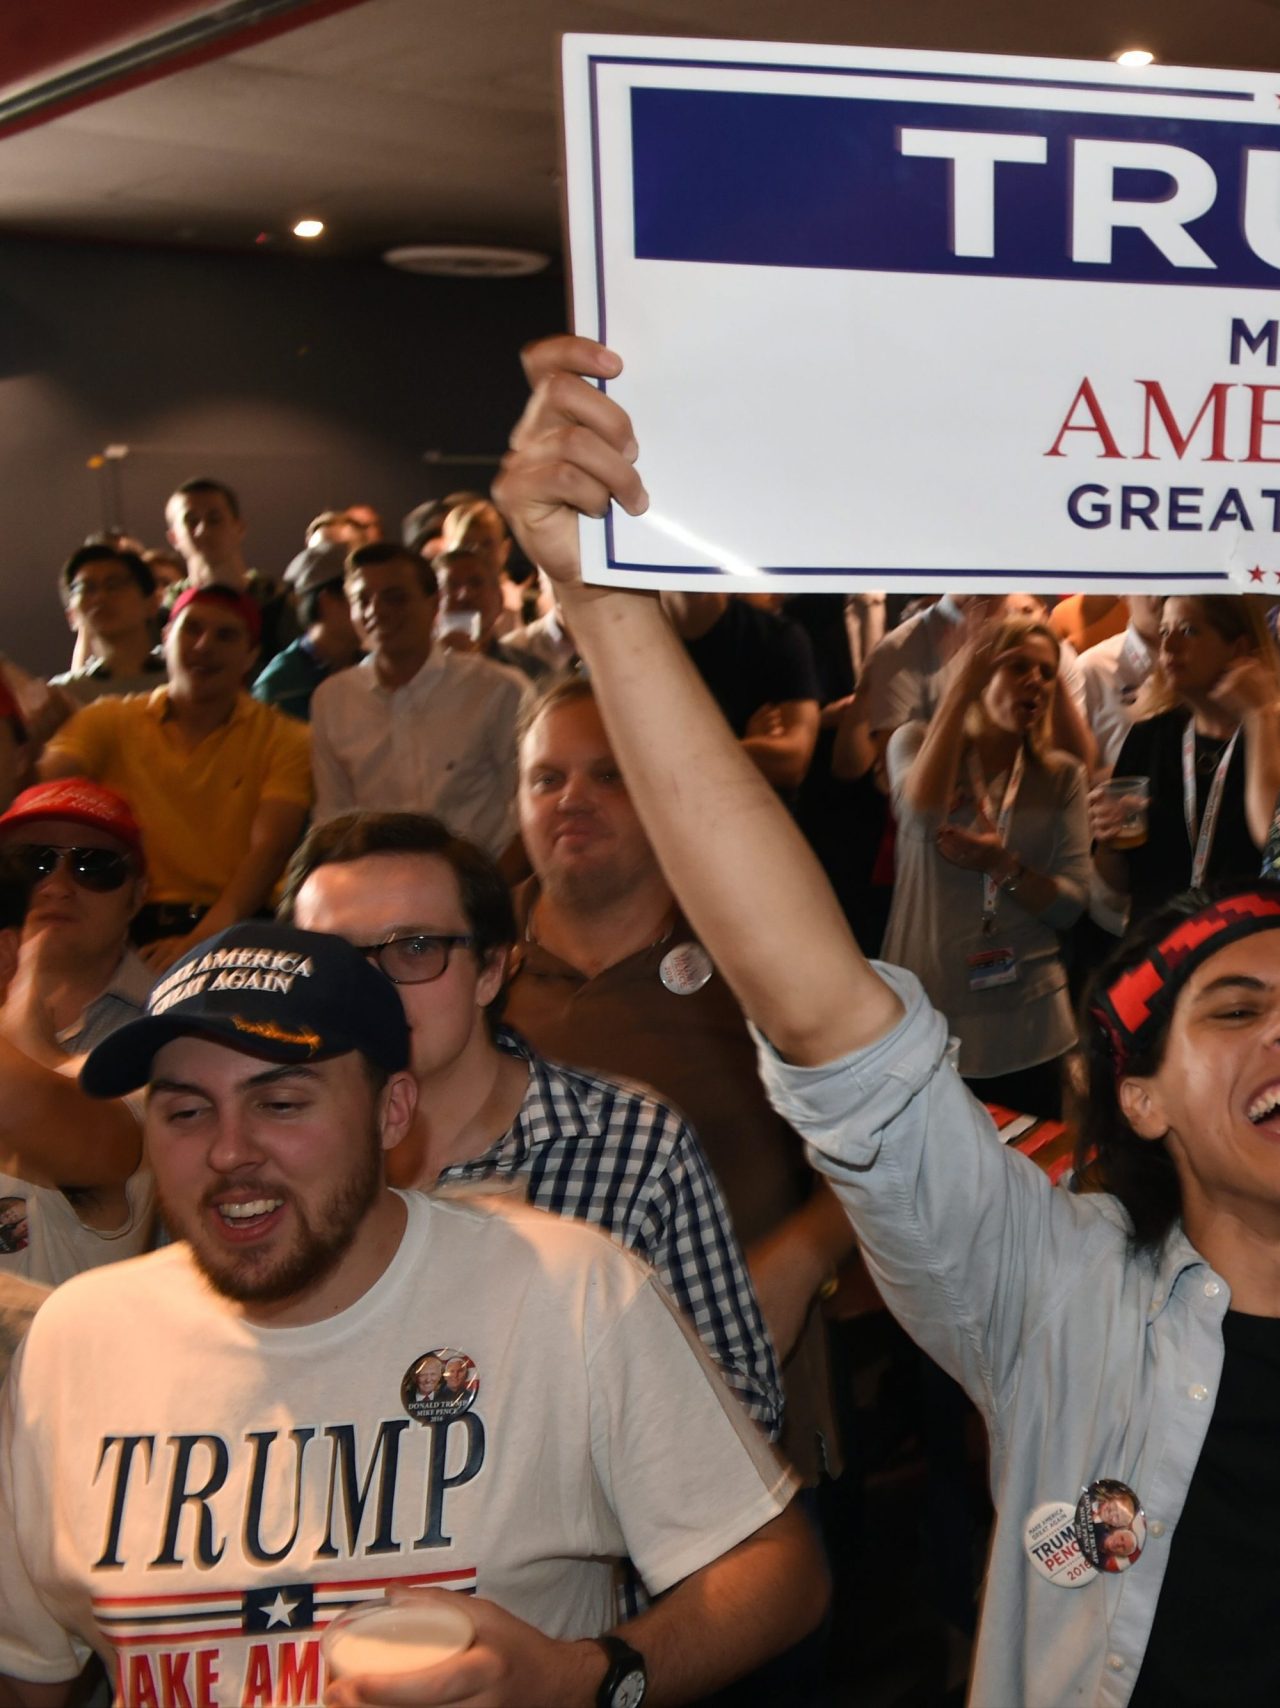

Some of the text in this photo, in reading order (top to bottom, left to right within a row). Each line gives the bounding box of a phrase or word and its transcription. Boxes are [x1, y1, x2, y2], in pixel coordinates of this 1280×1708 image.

[195, 949, 314, 977] AMERICA
[207, 968, 295, 994] AGAIN
[90, 1411, 486, 1573] TRUMP
[1032, 1524, 1077, 1562] TRUM
[1044, 1540, 1082, 1572] PENC
[1066, 1560, 1093, 1581] 2016
[116, 1648, 220, 1708] AKE
